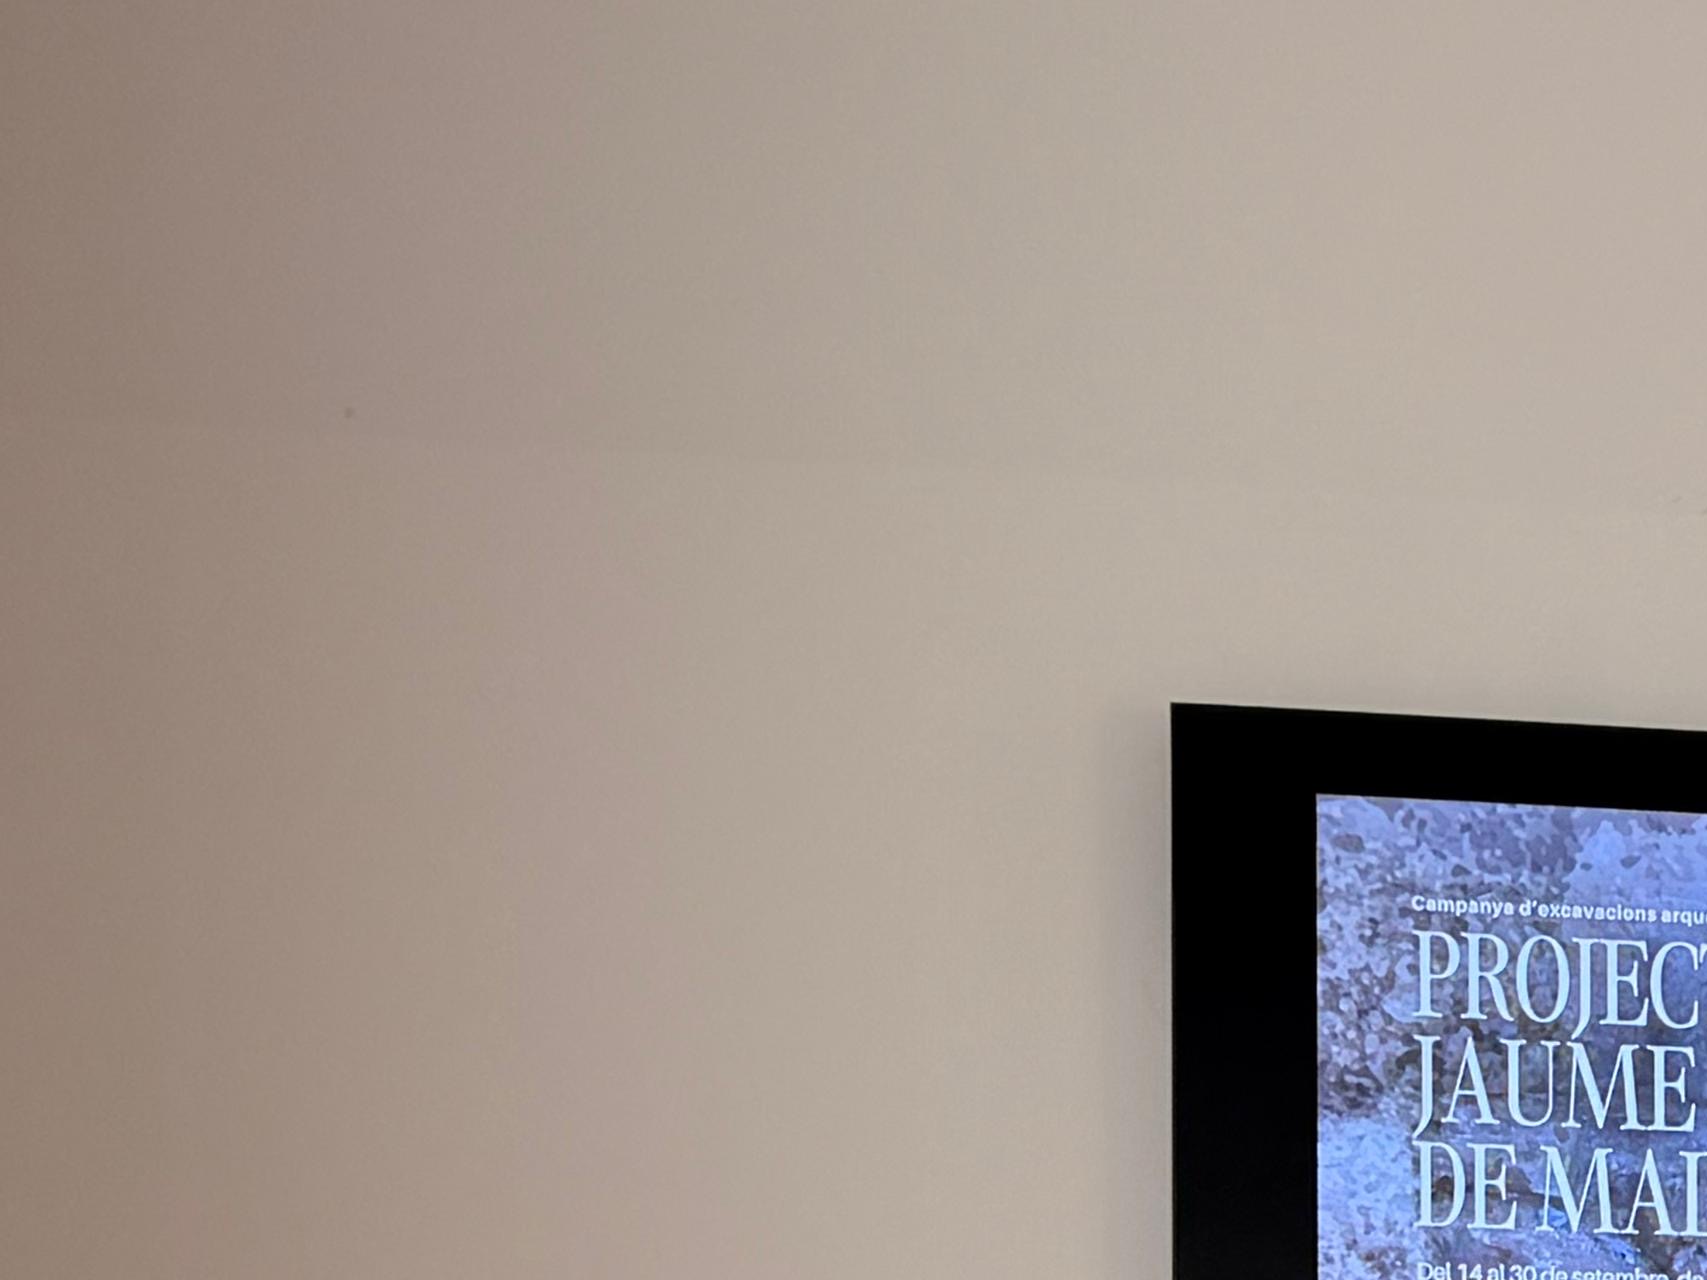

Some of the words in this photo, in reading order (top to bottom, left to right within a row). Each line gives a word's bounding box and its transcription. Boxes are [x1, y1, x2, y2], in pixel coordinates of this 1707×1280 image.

[1412, 896, 1513, 918] Campanya
[1411, 1034, 1695, 1139] JAUME
[1411, 1140, 1516, 1230] DE
